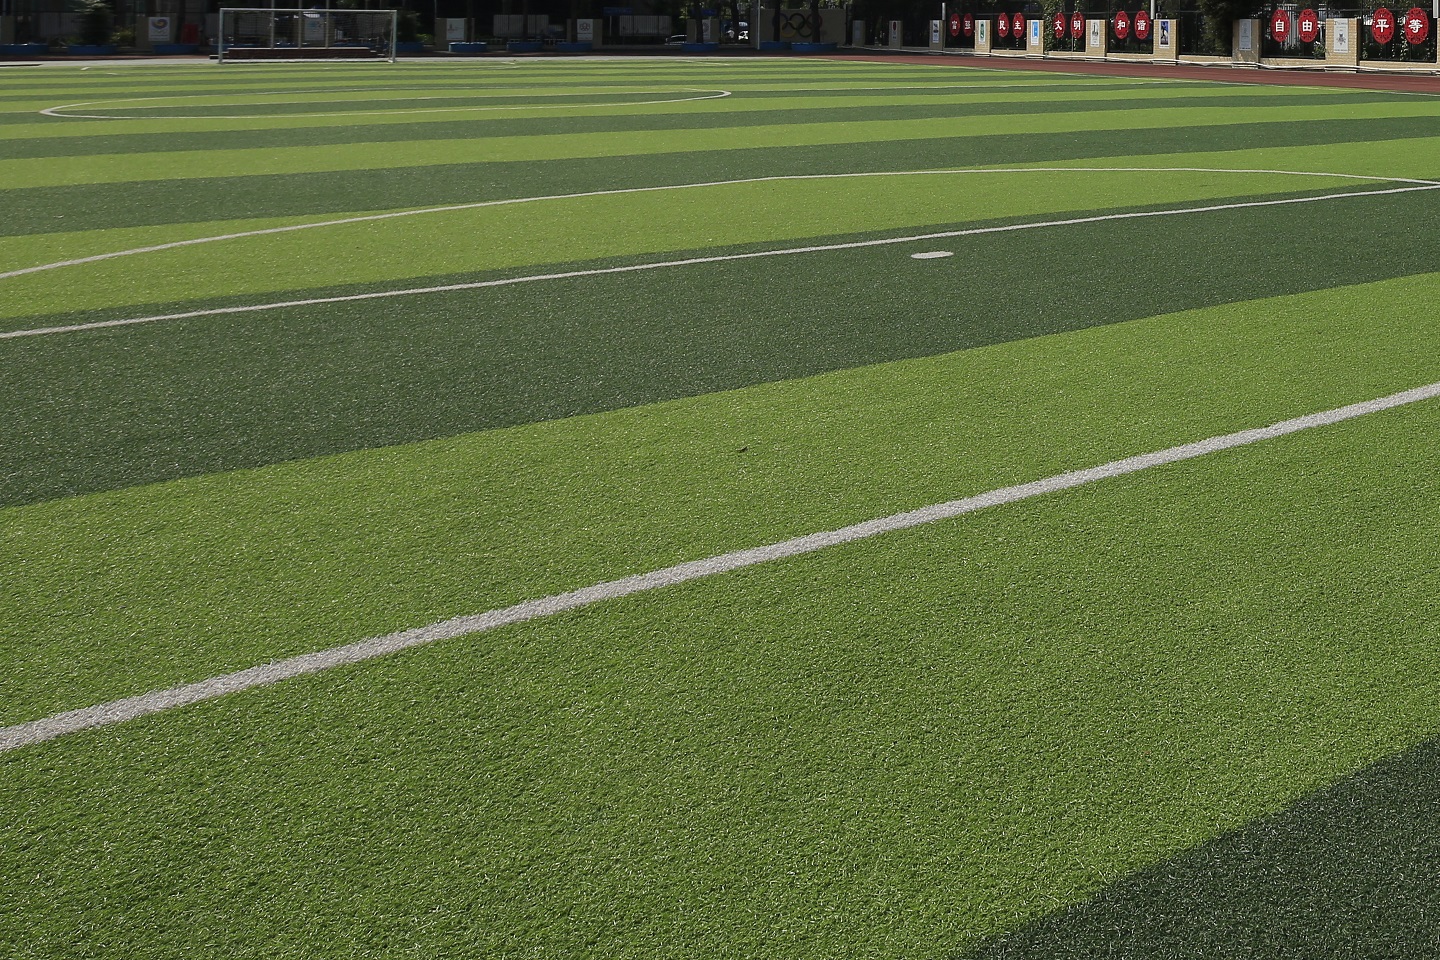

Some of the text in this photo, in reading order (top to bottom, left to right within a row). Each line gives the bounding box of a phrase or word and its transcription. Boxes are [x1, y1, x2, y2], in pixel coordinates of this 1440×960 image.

[999, 20, 1021, 30] 民 主
[1054, 20, 1081, 30] 文 明
[1117, 20, 1146, 30] 和 谐
[1275, 19, 1312, 32] 自 由
[1375, 19, 1423, 33] 平 等
